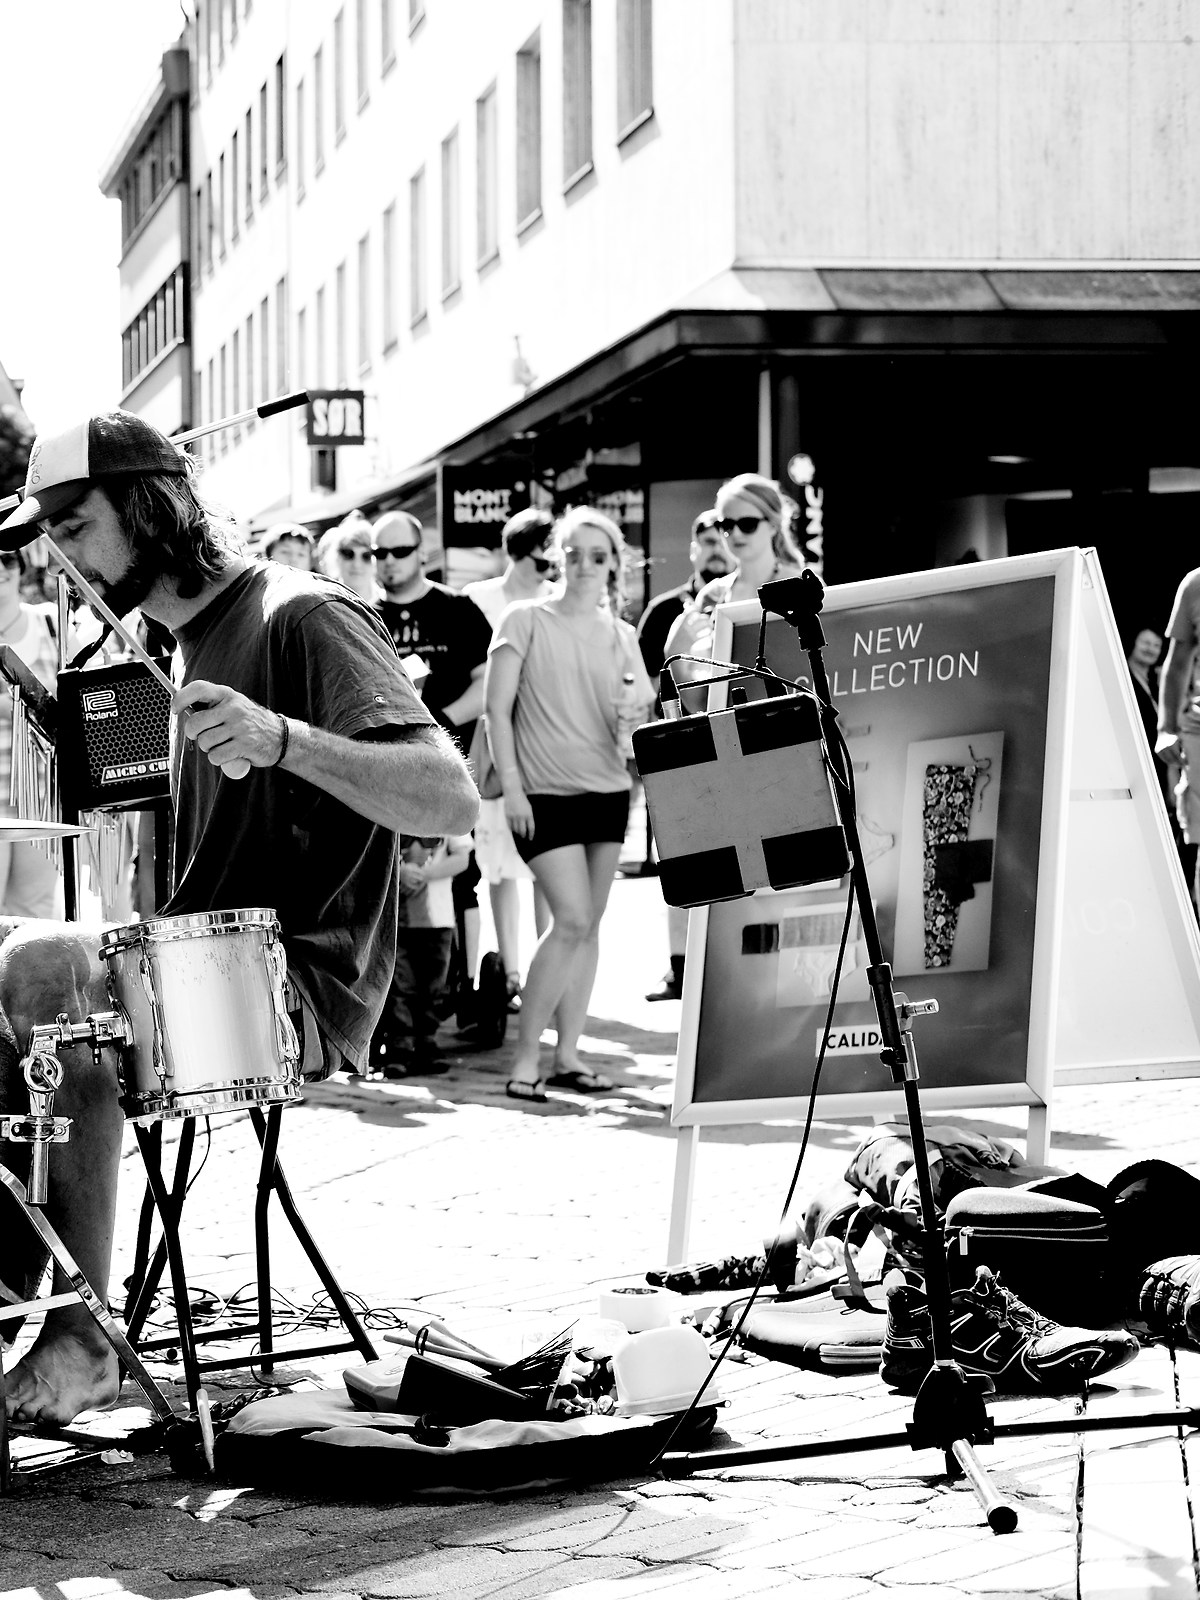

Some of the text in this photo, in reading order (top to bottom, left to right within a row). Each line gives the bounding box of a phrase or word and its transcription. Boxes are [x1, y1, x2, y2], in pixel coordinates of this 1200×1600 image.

[454, 489, 511, 506] MONT
[454, 505, 511, 523] BLANC
[853, 622, 923, 657] NEW
[85, 708, 118, 721] Roland
[105, 760, 170, 780] MICRO CU
[826, 1031, 884, 1049] CALID
